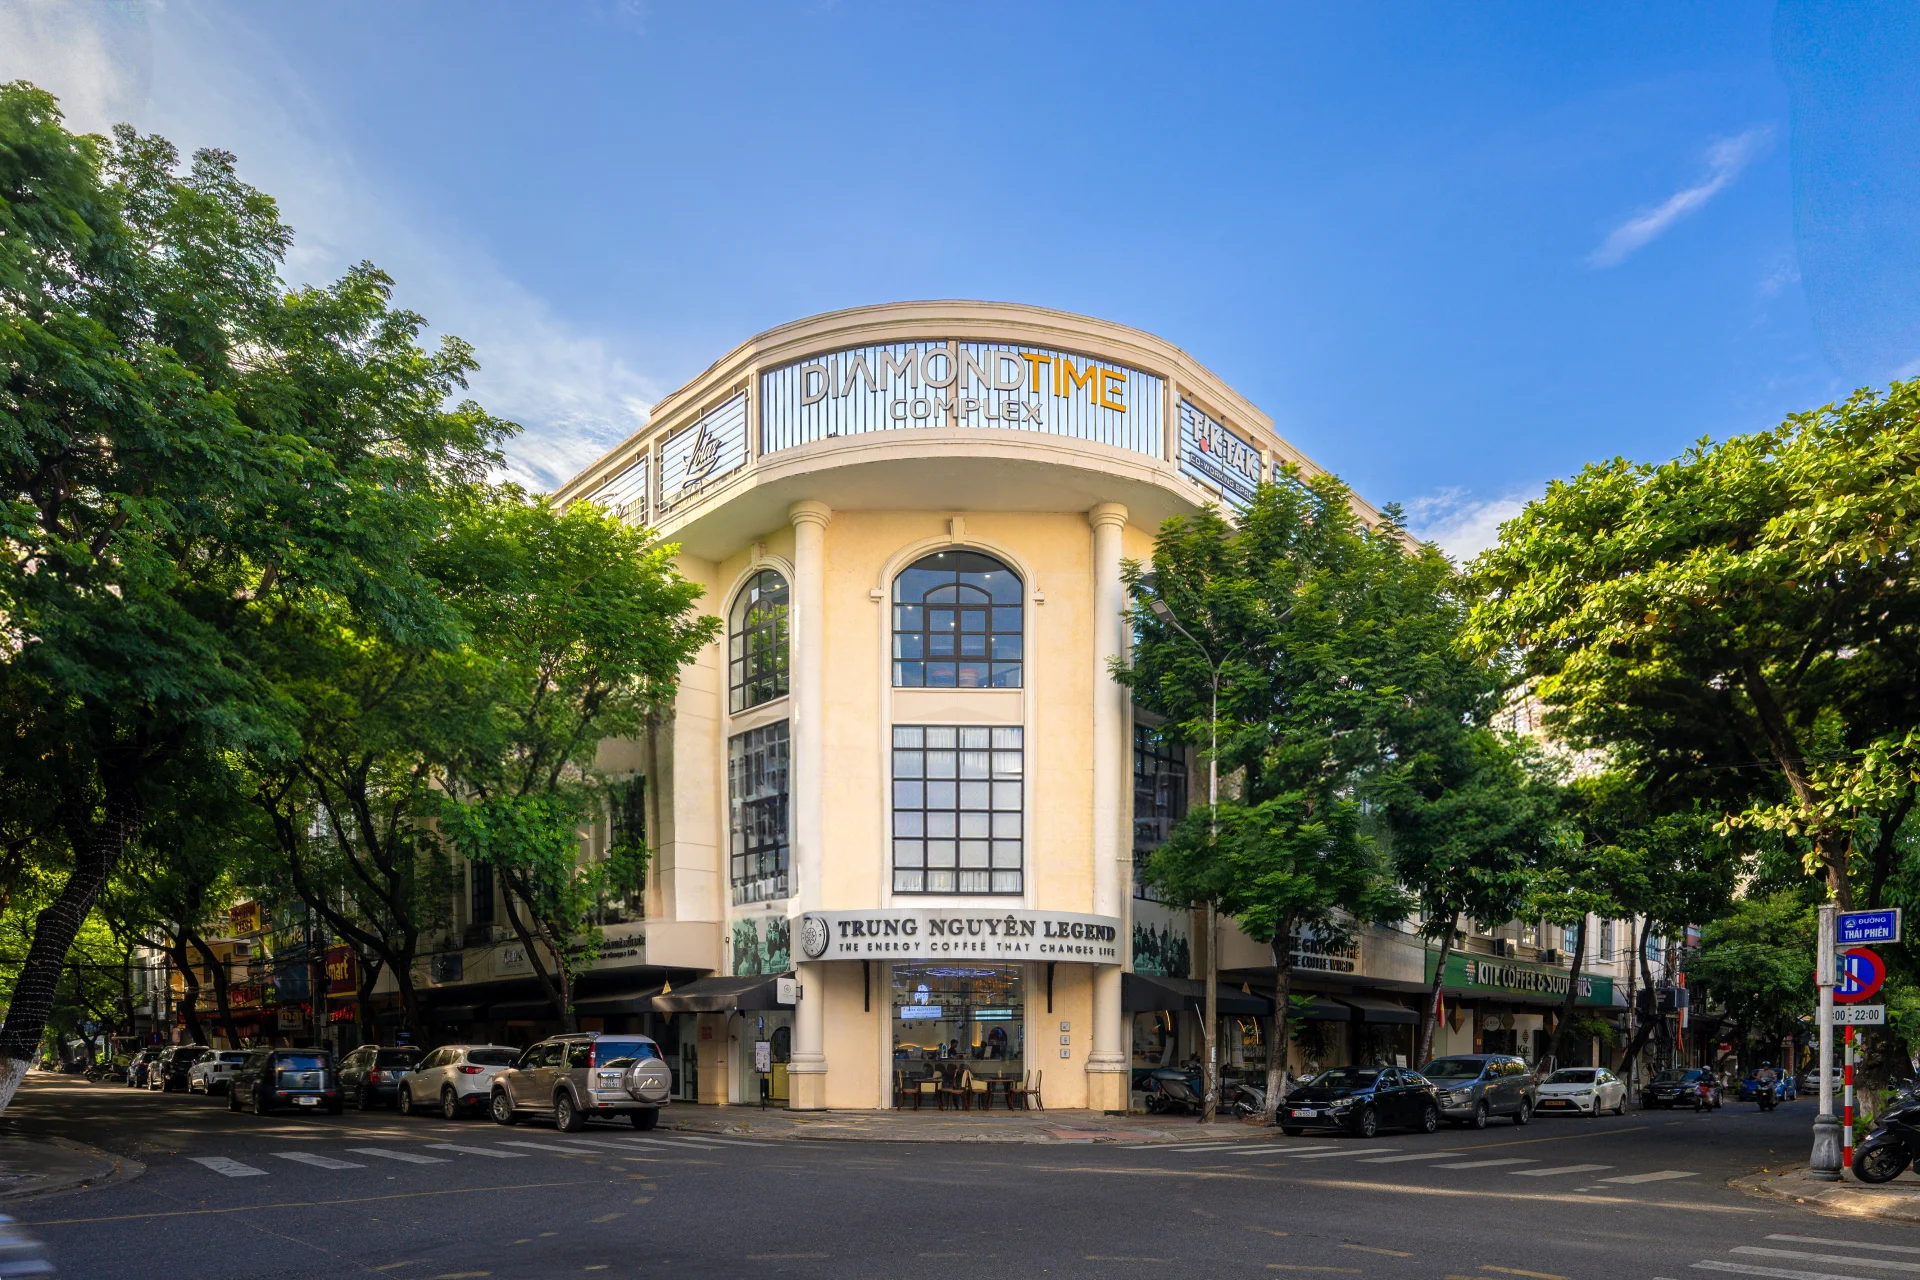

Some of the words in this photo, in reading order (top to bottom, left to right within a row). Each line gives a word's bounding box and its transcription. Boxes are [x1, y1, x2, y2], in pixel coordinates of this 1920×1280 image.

[889, 396, 1044, 425] COMPLEX
[1189, 454, 1235, 489] CO-WORKING
[838, 918, 918, 937] TRUNG
[929, 914, 1037, 937] NGUYÊN
[1043, 920, 1117, 942] LEGEND
[1844, 926, 1862, 940] THÁI
[839, 942, 859, 952] THE
[867, 942, 921, 952] ENERGY
[931, 942, 986, 952] COFFEE
[997, 943, 1030, 952] THAT
[1040, 944, 1094, 955] CHANGES
[1099, 947, 1116, 957] LIFE
[1478, 961, 1500, 986] KITE
[1502, 966, 1536, 991] COFFEE
[1854, 1009, 1880, 1021] 22:00
